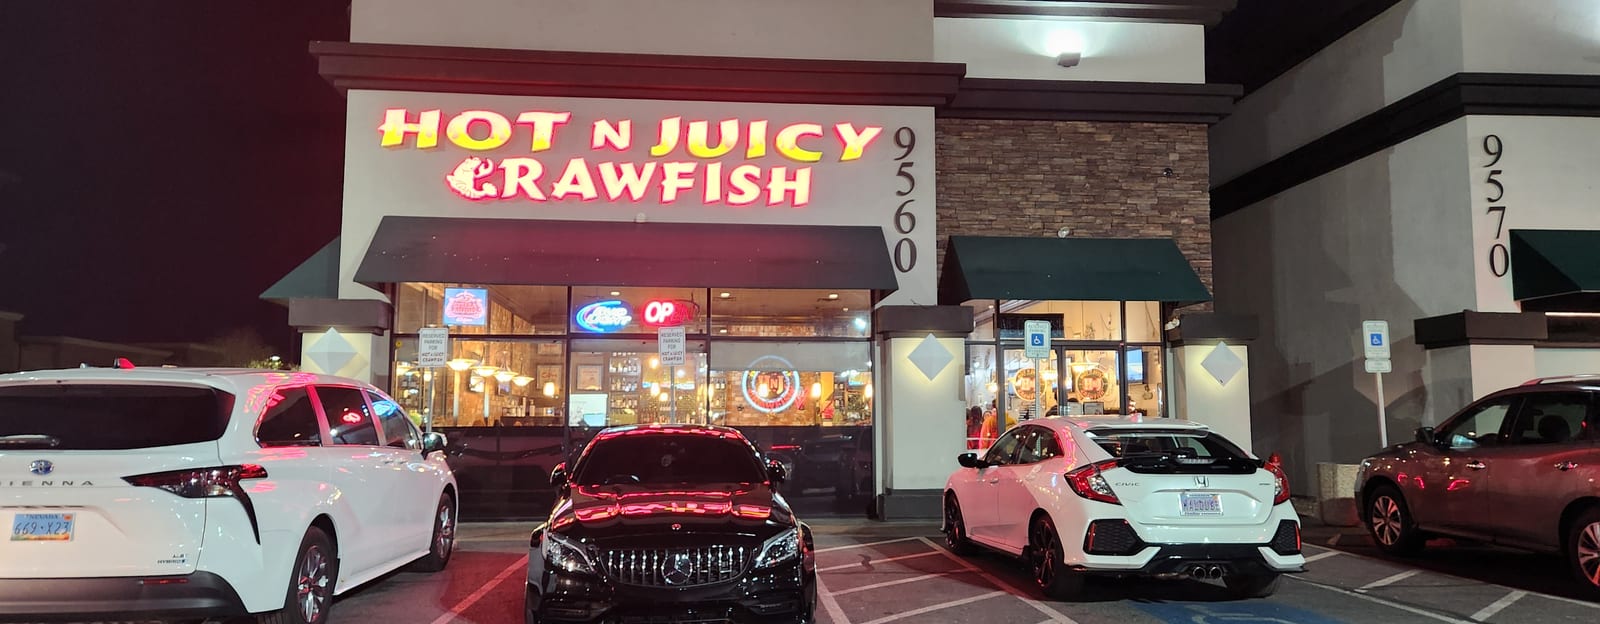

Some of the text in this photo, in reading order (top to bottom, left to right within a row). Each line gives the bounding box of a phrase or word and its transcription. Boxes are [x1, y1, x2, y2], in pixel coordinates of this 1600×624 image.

[378, 108, 884, 162] HOT N JUICY
[893, 126, 917, 273] 9560
[1482, 134, 1509, 277] 9570
